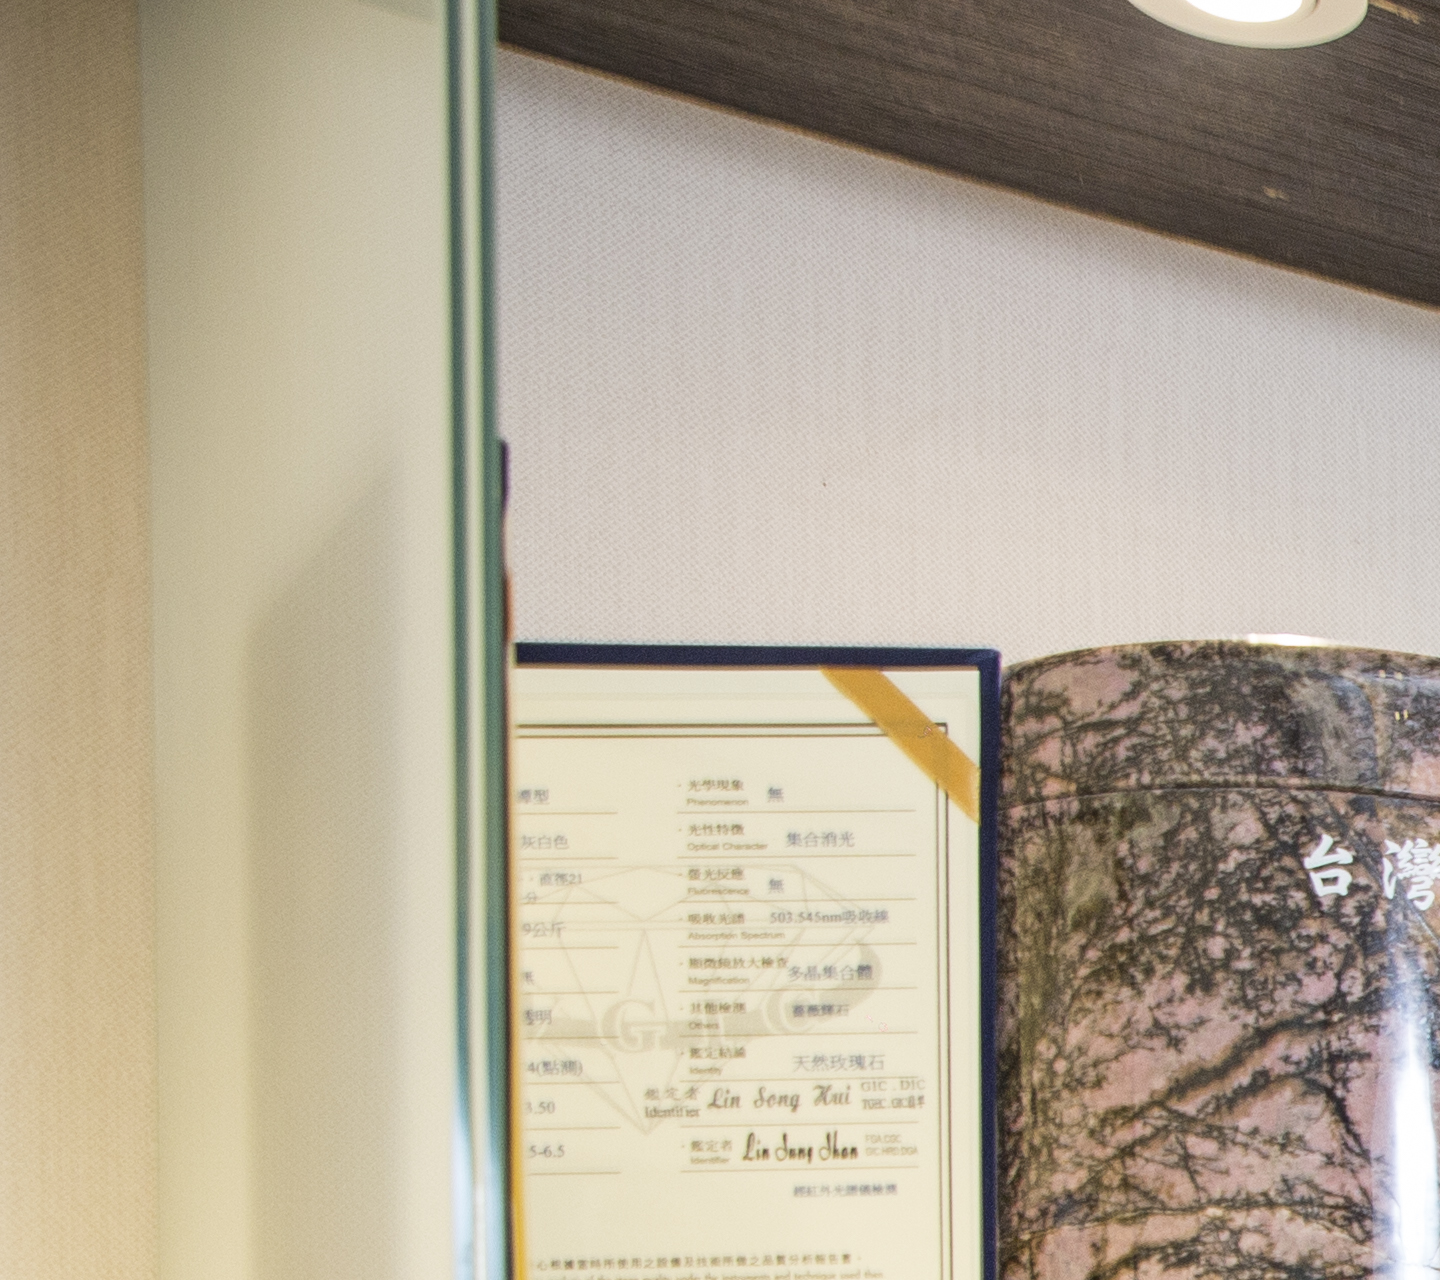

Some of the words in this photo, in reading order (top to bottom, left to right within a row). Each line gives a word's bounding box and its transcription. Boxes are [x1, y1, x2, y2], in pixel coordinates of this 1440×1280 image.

[767, 787, 784, 803] 無
[686, 798, 749, 806] Phenomenon
[522, 834, 569, 850] 灰白色
[687, 842, 720, 851] Optical
[722, 842, 768, 851] Character
[687, 886, 750, 896] Fluorescence
[768, 878, 784, 893] 無
[688, 931, 737, 941] Absorption
[740, 931, 786, 940] Spectrum
[688, 975, 750, 986] Magnification
[688, 1021, 720, 1030] Others
[792, 1054, 886, 1073] 天然玫瑰石
[645, 1106, 700, 1119] Identifier
